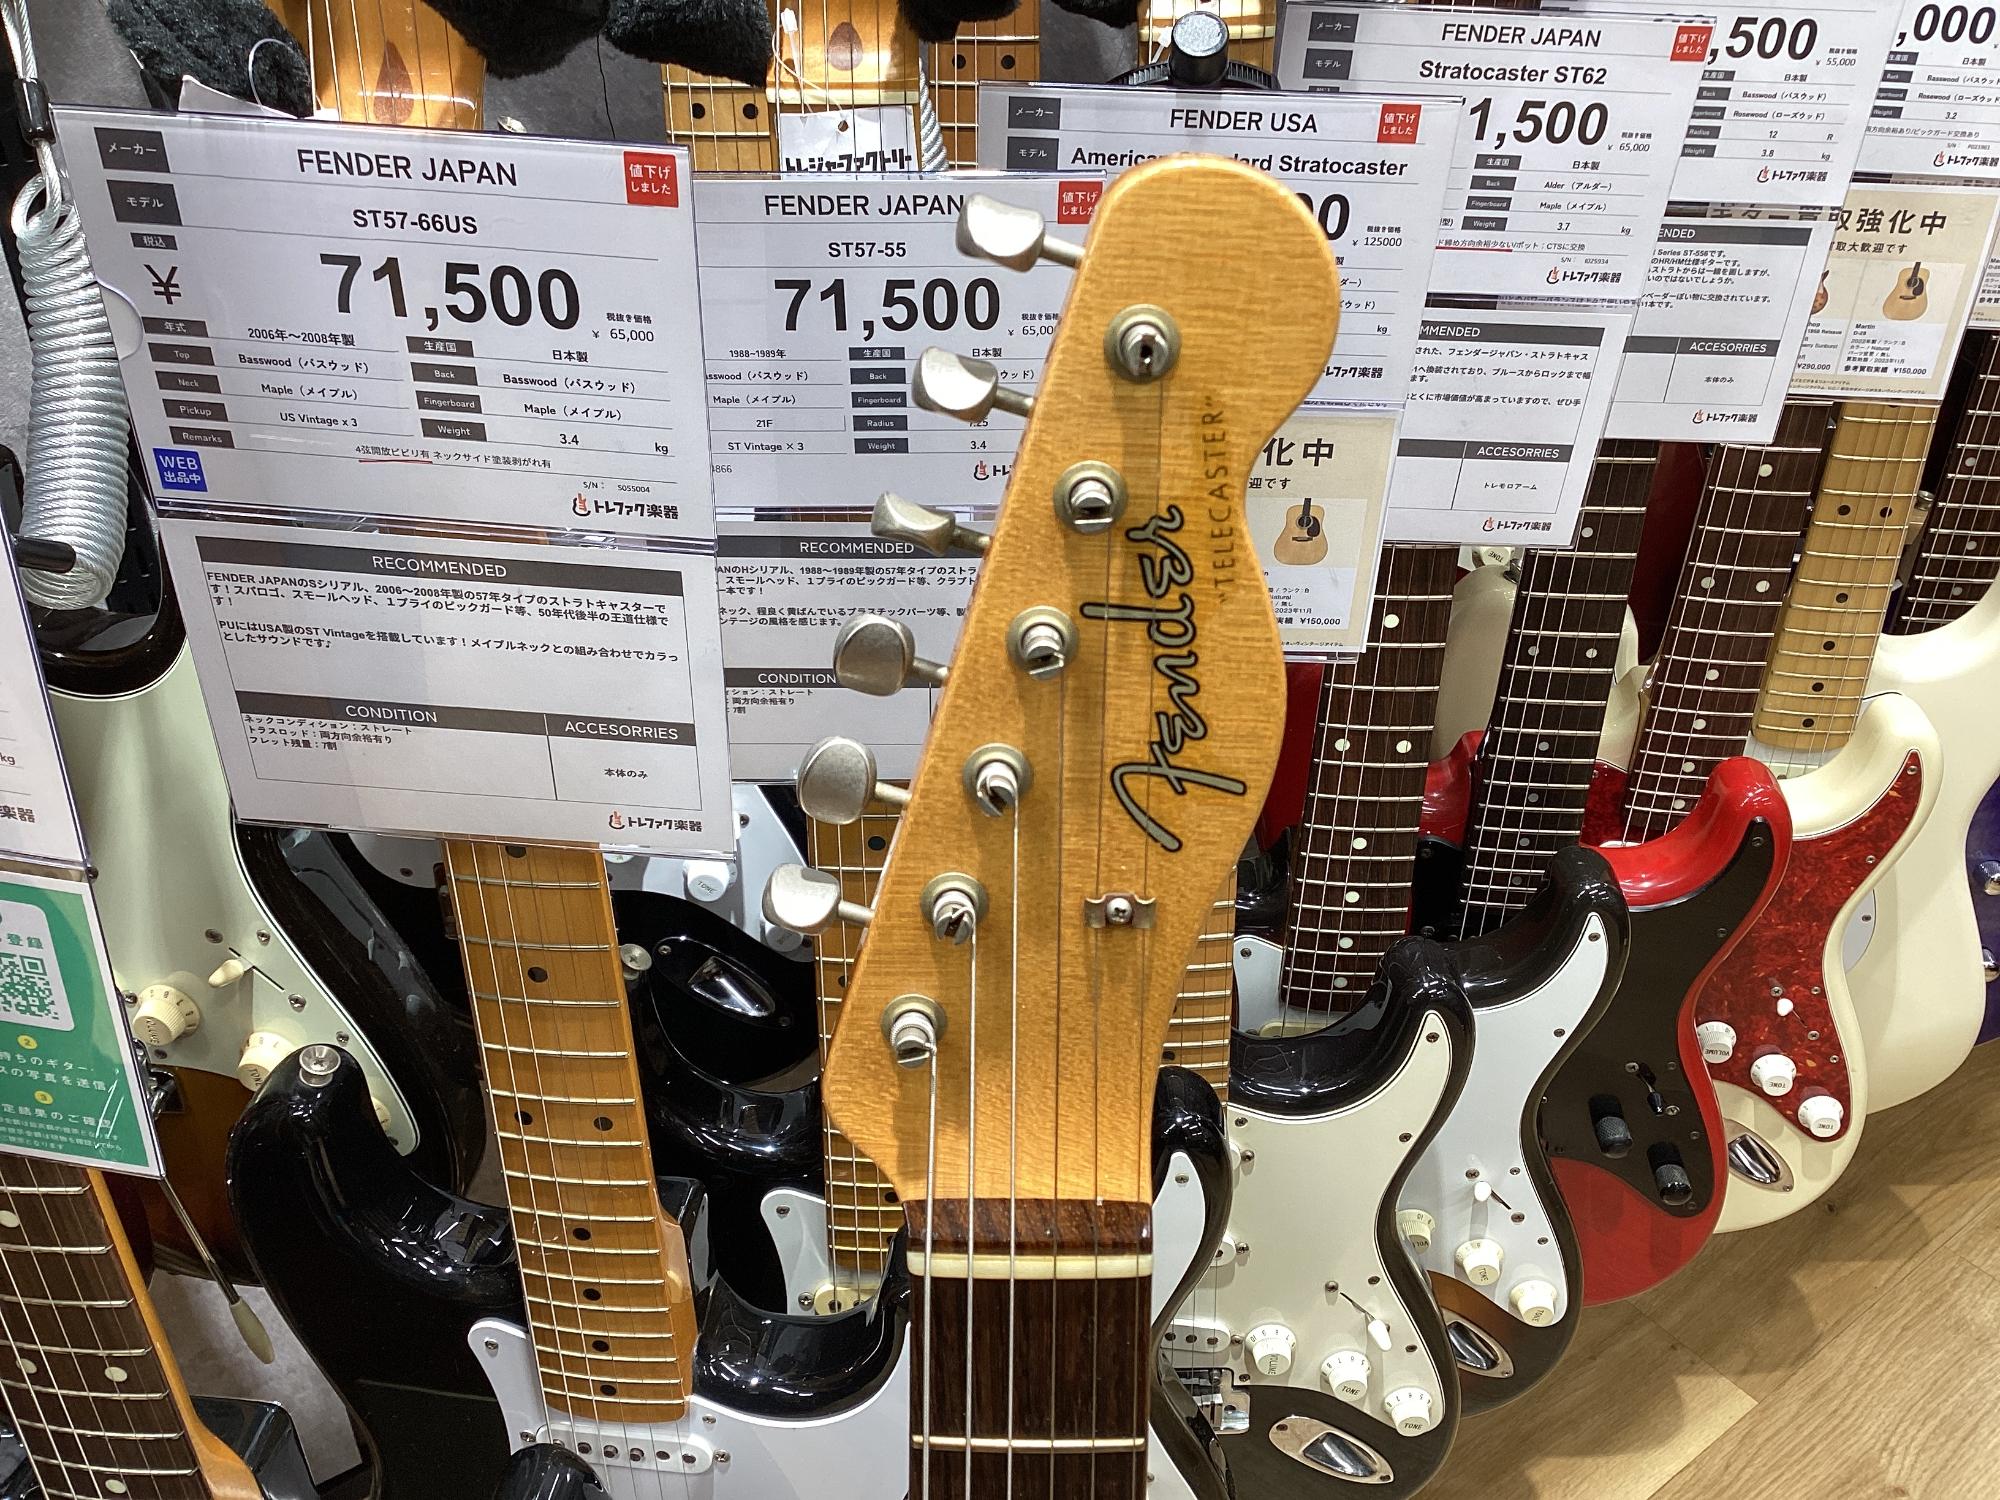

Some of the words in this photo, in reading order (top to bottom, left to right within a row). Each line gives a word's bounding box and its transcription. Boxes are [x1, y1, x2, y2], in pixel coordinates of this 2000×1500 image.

[1316, 22, 1351, 30] メーカー
[1441, 23, 1526, 44] FENDER
[1531, 27, 1602, 48] JAPAN
[1678, 32, 1706, 44] 値下げ
[1675, 44, 1703, 55] しました
[1315, 60, 1341, 68] モデル
[1826, 57, 1856, 67] 55,000
[1419, 60, 1549, 83] Stratocaster
[1553, 67, 1608, 85] ST62
[1784, 74, 1808, 82] 日本製
[1742, 91, 1777, 99] Basswood
[1015, 106, 1054, 119] メーカー
[1384, 112, 1415, 123] 値下げ
[1733, 110, 1768, 118] Rosewood
[1945, 111, 1957, 120] 3.2
[1170, 109, 1262, 131] FENDER
[1270, 113, 1317, 133] USA
[1464, 97, 1609, 150] 1,500
[1382, 124, 1412, 135] しました
[1769, 130, 1778, 139] 12
[108, 143, 157, 155] メーカー
[1019, 148, 1048, 158] モデル
[1619, 143, 1650, 152] 65,000
[1761, 149, 1774, 157] 3.8
[1821, 153, 1830, 161] kg
[297, 149, 412, 180] FENDER
[421, 157, 518, 187] JAPAN
[629, 163, 671, 179] 値下げ
[1279, 154, 1408, 177] Stratocaster
[1572, 161, 1600, 171] 日本製
[1771, 170, 1828, 182] トレファク楽器
[631, 182, 671, 195] しました
[1544, 182, 1565, 190] Alder
[126, 196, 163, 208] モデル
[1063, 191, 1098, 203] 値下げ
[765, 195, 869, 216] FENDER
[878, 194, 964, 216] JAPAN
[1471, 200, 1507, 209] Fingerboard
[1539, 202, 1562, 210] Maple
[352, 209, 478, 235] ST57-66US
[1473, 220, 1496, 228] Weight
[1557, 223, 1571, 231] 3.7
[1620, 226, 1631, 235] kg
[143, 235, 166, 248] 税込
[1364, 237, 1402, 247] 125000
[828, 243, 906, 258] ST57-55
[1562, 271, 1622, 284] トレファク楽器
[143, 264, 182, 305] ¥
[319, 253, 580, 332] 71,500
[774, 278, 1000, 341] 71,500
[606, 312, 652, 324] 税抜き価格
[164, 322, 186, 333] 年式
[1022, 325, 1054, 337] 65,00
[1377, 325, 1388, 334] kg
[610, 328, 654, 342] 65,000
[424, 340, 457, 352] 生産国
[552, 350, 588, 362] 日本製
[863, 349, 891, 358] 生産国
[972, 348, 1003, 357] 日本製
[1689, 341, 1768, 353] ACCESORRIES
[174, 350, 190, 360] Top
[238, 354, 292, 368] Basswood
[706, 372, 742, 380] asswood
[1322, 366, 1383, 378] レファク楽器
[1894, 367, 1927, 375] ¥150,000
[434, 370, 455, 379] Back
[503, 374, 557, 387] Basswood
[178, 378, 199, 387] Neck
[261, 384, 293, 396] Maple
[424, 397, 475, 409] Fingerboard
[524, 404, 557, 416] Maple
[713, 396, 740, 405] Maple
[857, 396, 901, 406] Fingerboard
[179, 406, 212, 417] Pickup
[280, 412, 295, 422] US
[298, 413, 339, 427] Vintage
[350, 418, 358, 427] 3
[1706, 413, 1758, 424] トレファク楽器
[756, 420, 773, 428] 21F
[867, 419, 894, 428] Radius
[182, 433, 223, 443] Remarks
[437, 425, 471, 437] Weight
[559, 434, 580, 446] 3.4
[655, 443, 669, 455] kg
[728, 442, 741, 451] ST
[744, 442, 782, 452] Vintage
[797, 442, 804, 451] 3
[867, 442, 896, 452] Weight
[970, 441, 987, 450] 3.4
[1477, 446, 1560, 459] ACCESORRIES
[158, 455, 198, 471] WEB
[163, 470, 201, 484] 出品中
[1484, 482, 1537, 490] トレモロアーム
[594, 500, 679, 520] トレファク楽器
[1497, 520, 1552, 532] トレファク楽器
[800, 542, 914, 554] RECOMMENDED
[372, 556, 507, 578] RECOMMENDED
[207, 571, 255, 584] FENDER
[1300, 617, 1341, 625] ¥150,000
[758, 673, 836, 684] CONDITION
[1080, 504, 1248, 853] Fender
[346, 705, 438, 722] CONDITION
[565, 721, 678, 740] ACCESORRIES
[604, 768, 648, 780] 本体のみ
[628, 817, 702, 832] トレファク楽器
[1341, 1386, 1359, 1396] TONE
[1404, 1423, 1423, 1431] TONE
